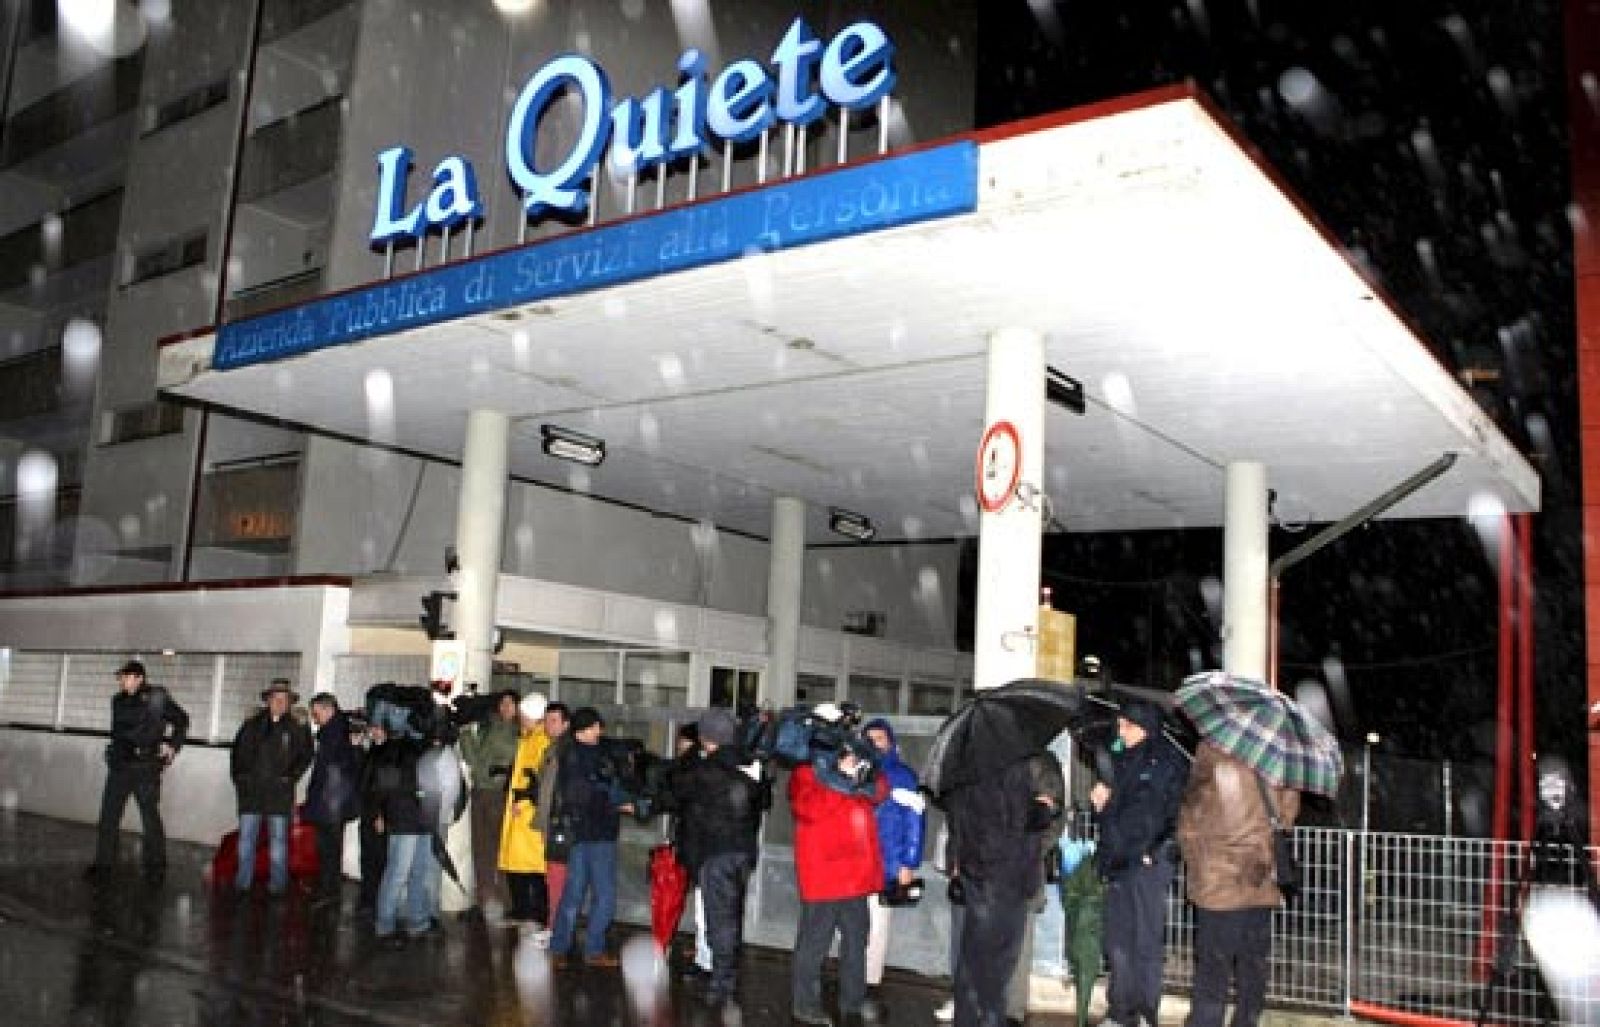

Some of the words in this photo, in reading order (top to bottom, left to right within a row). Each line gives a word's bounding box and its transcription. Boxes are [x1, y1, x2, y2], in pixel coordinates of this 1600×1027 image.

[370, 146, 481, 250] La
[506, 18, 897, 221] Quiete
[219, 310, 316, 361] Azienda
[330, 283, 447, 336] Pubblica
[464, 263, 494, 304] di
[513, 226, 637, 292] Servizi
[657, 207, 731, 261] alla
[764, 176, 953, 233] Persona
